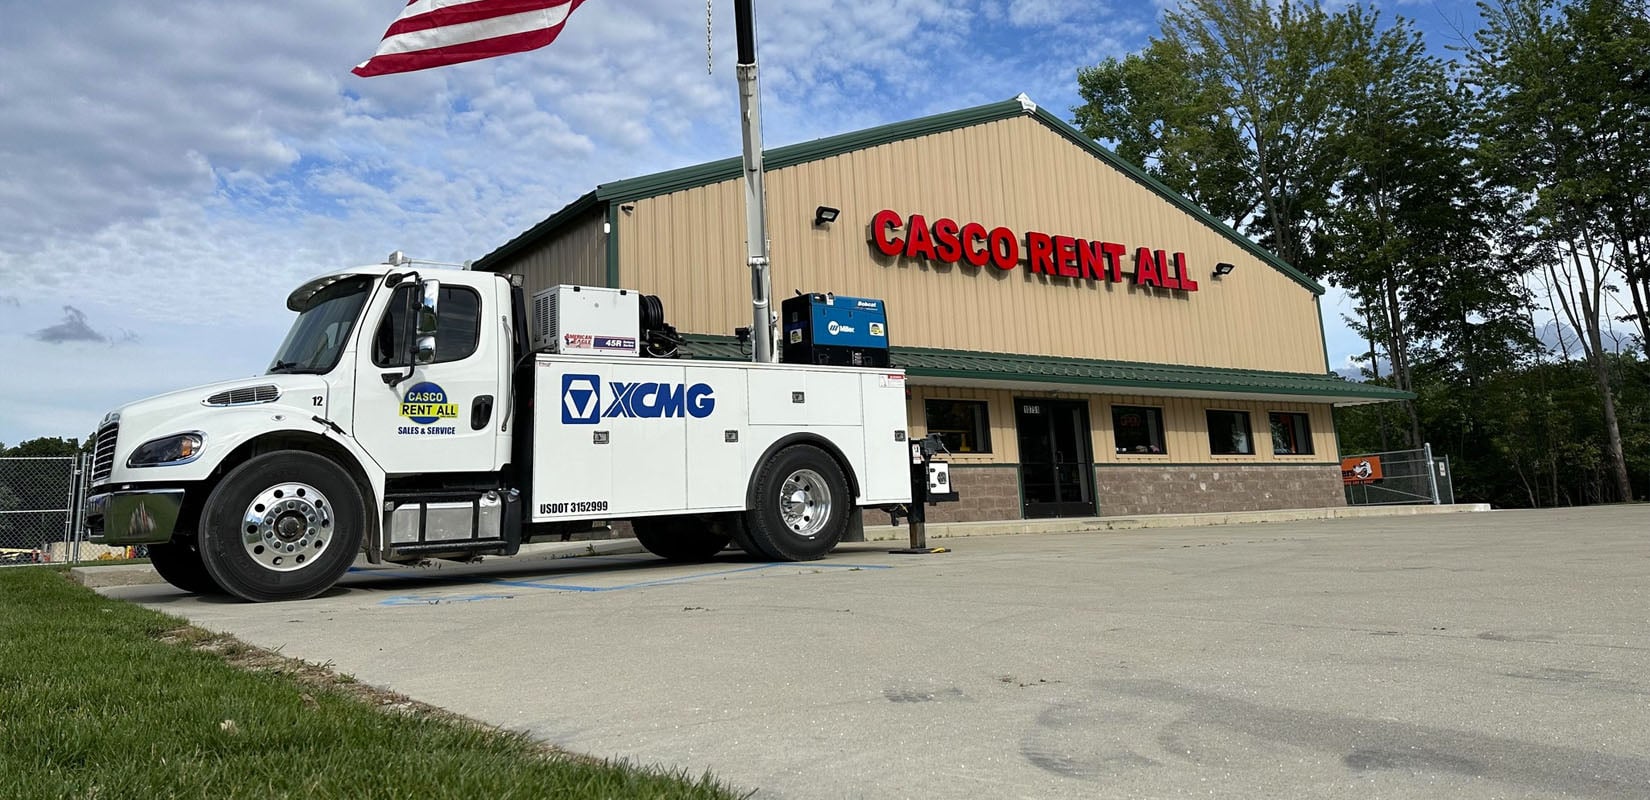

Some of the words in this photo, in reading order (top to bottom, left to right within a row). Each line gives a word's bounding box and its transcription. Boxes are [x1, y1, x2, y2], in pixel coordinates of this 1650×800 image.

[871, 209, 1020, 271] CASCO
[1025, 231, 1127, 283] RENT
[1135, 247, 1198, 292] ALL
[857, 300, 877, 308] Bobcat
[605, 339, 622, 347] 45R
[312, 395, 323, 406] 12
[408, 392, 443, 402] CASCO
[601, 382, 715, 418] XCMG
[402, 404, 433, 415] RENT
[436, 404, 456, 416] ALL
[398, 426, 420, 435] SALES
[420, 427, 425, 435] &
[427, 426, 456, 435] SERVICE
[540, 502, 569, 514] USDOT
[570, 501, 608, 513] 3152999
